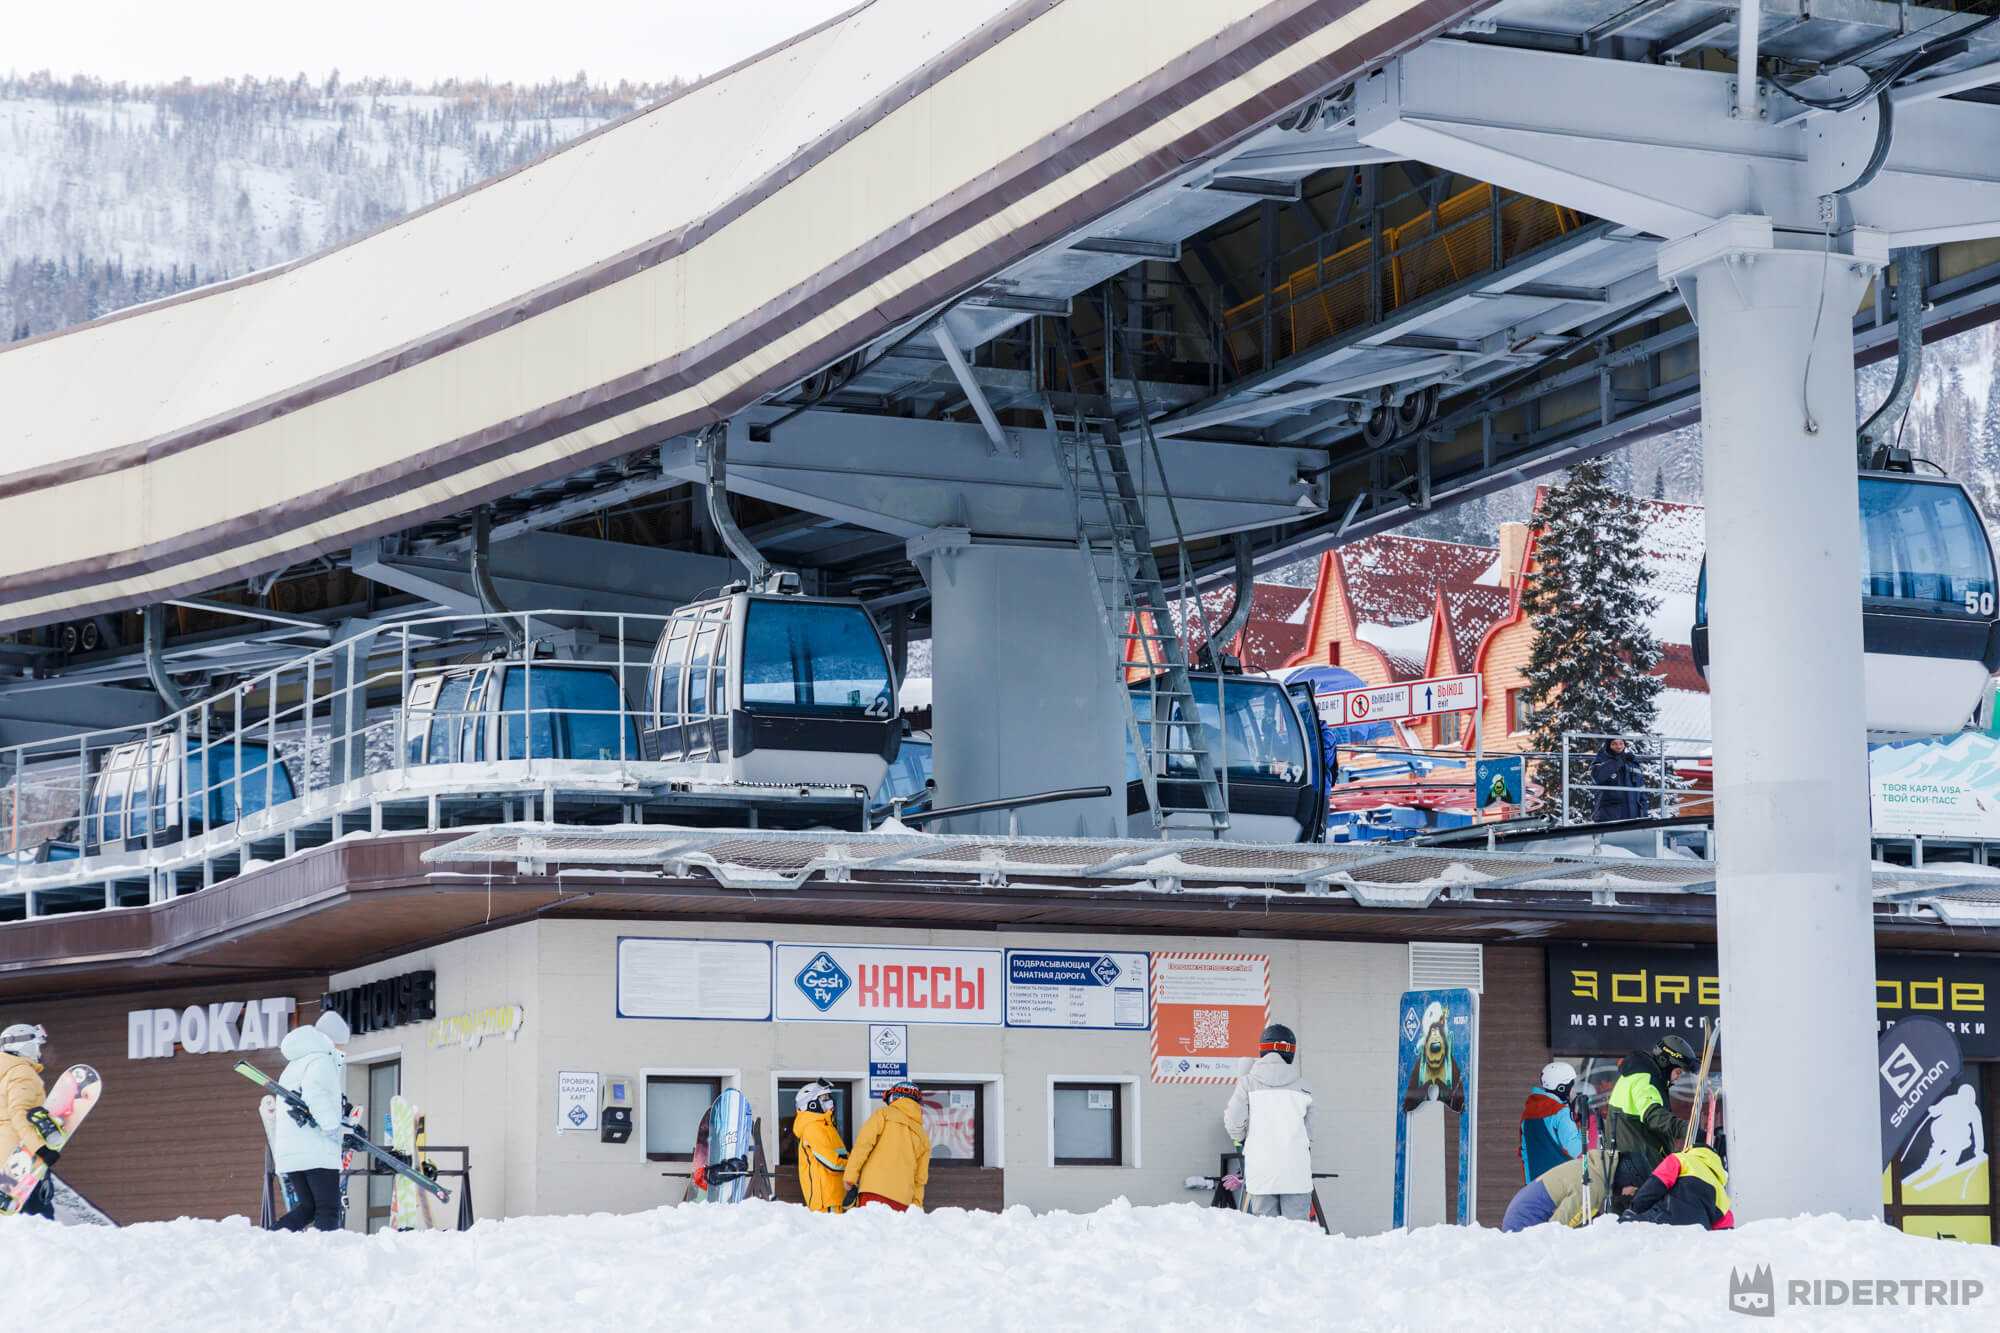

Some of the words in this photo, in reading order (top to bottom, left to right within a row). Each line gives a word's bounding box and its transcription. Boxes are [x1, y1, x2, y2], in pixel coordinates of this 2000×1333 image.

[1965, 592, 1994, 615] 50
[1437, 682, 1464, 697] ВЫХОД
[864, 696, 888, 717] 22
[1280, 765, 1303, 783] 49
[1882, 783, 1907, 792] ТВОЯ
[1909, 784, 1938, 793] КАРТА
[1941, 786, 1961, 794] VISA
[1882, 793, 1908, 802] ТВОЙ
[1910, 795, 1957, 805] СКИ-ПАСС
[1013, 959, 1090, 969] ПОДБРАСЫВАЮЩАЯ
[803, 971, 843, 989] Gesh
[1013, 971, 1053, 980] КАНАТНАЯ
[1054, 972, 1086, 981] ДОРОГА
[858, 964, 985, 1010] КАССЫ
[814, 988, 831, 1002] Fly
[128, 997, 296, 1060] ПРОКАТ
[1570, 1014, 1675, 1028] магазин
